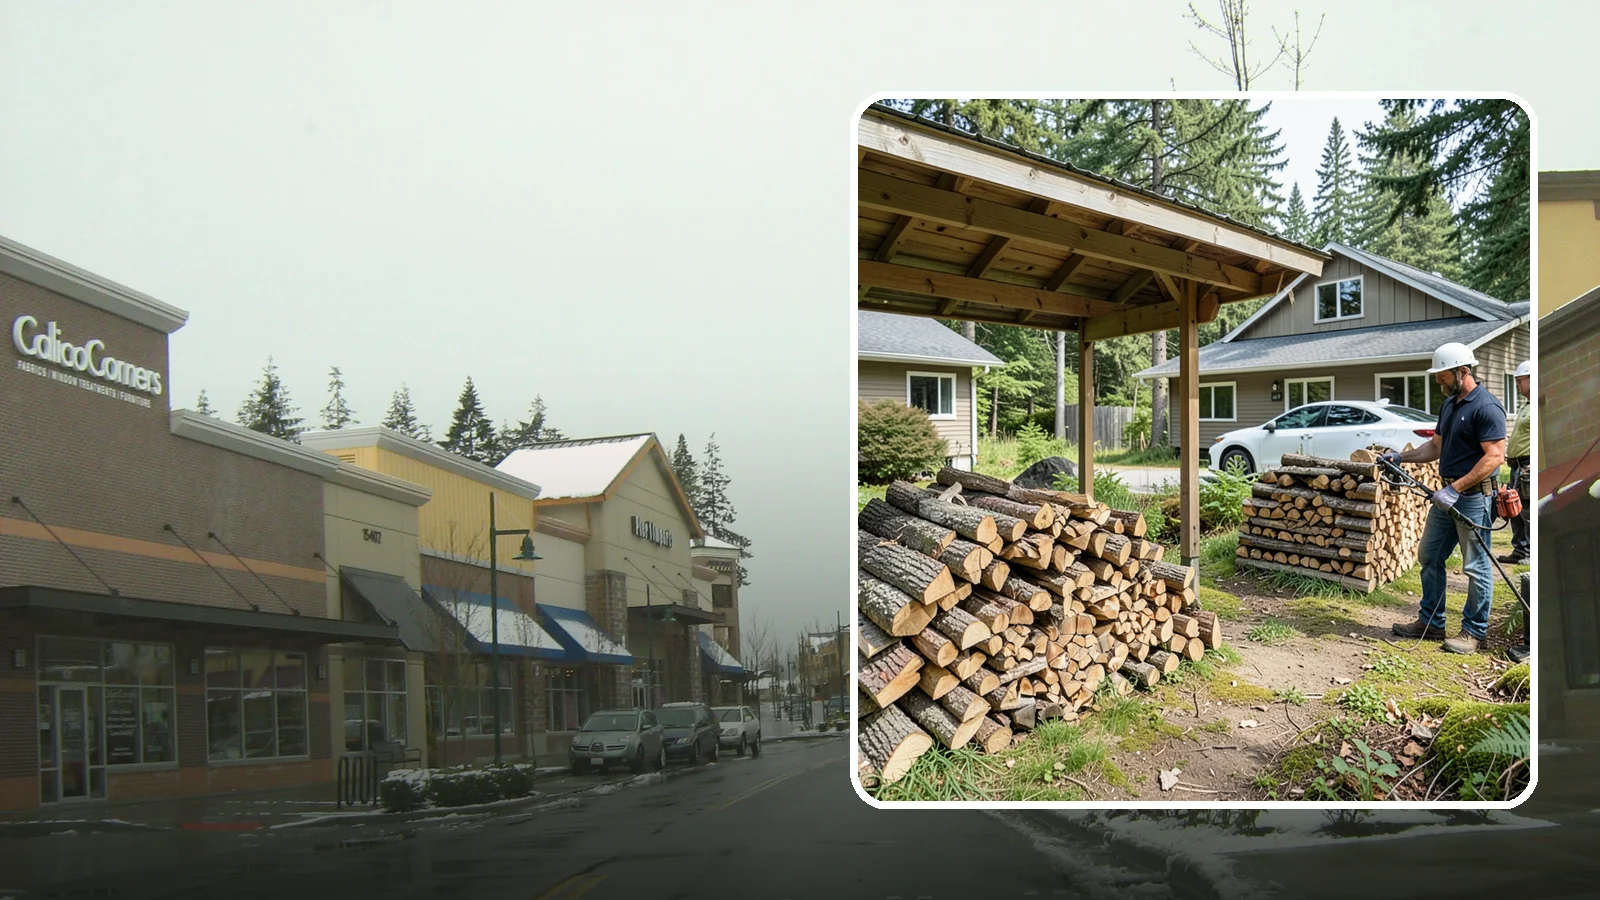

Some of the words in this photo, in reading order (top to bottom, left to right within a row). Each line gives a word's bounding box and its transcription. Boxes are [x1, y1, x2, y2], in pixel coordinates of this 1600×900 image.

[17, 360, 47, 377] FABRICS
[51, 370, 78, 387] WINDOW
[79, 378, 117, 398] TREATMENTS
